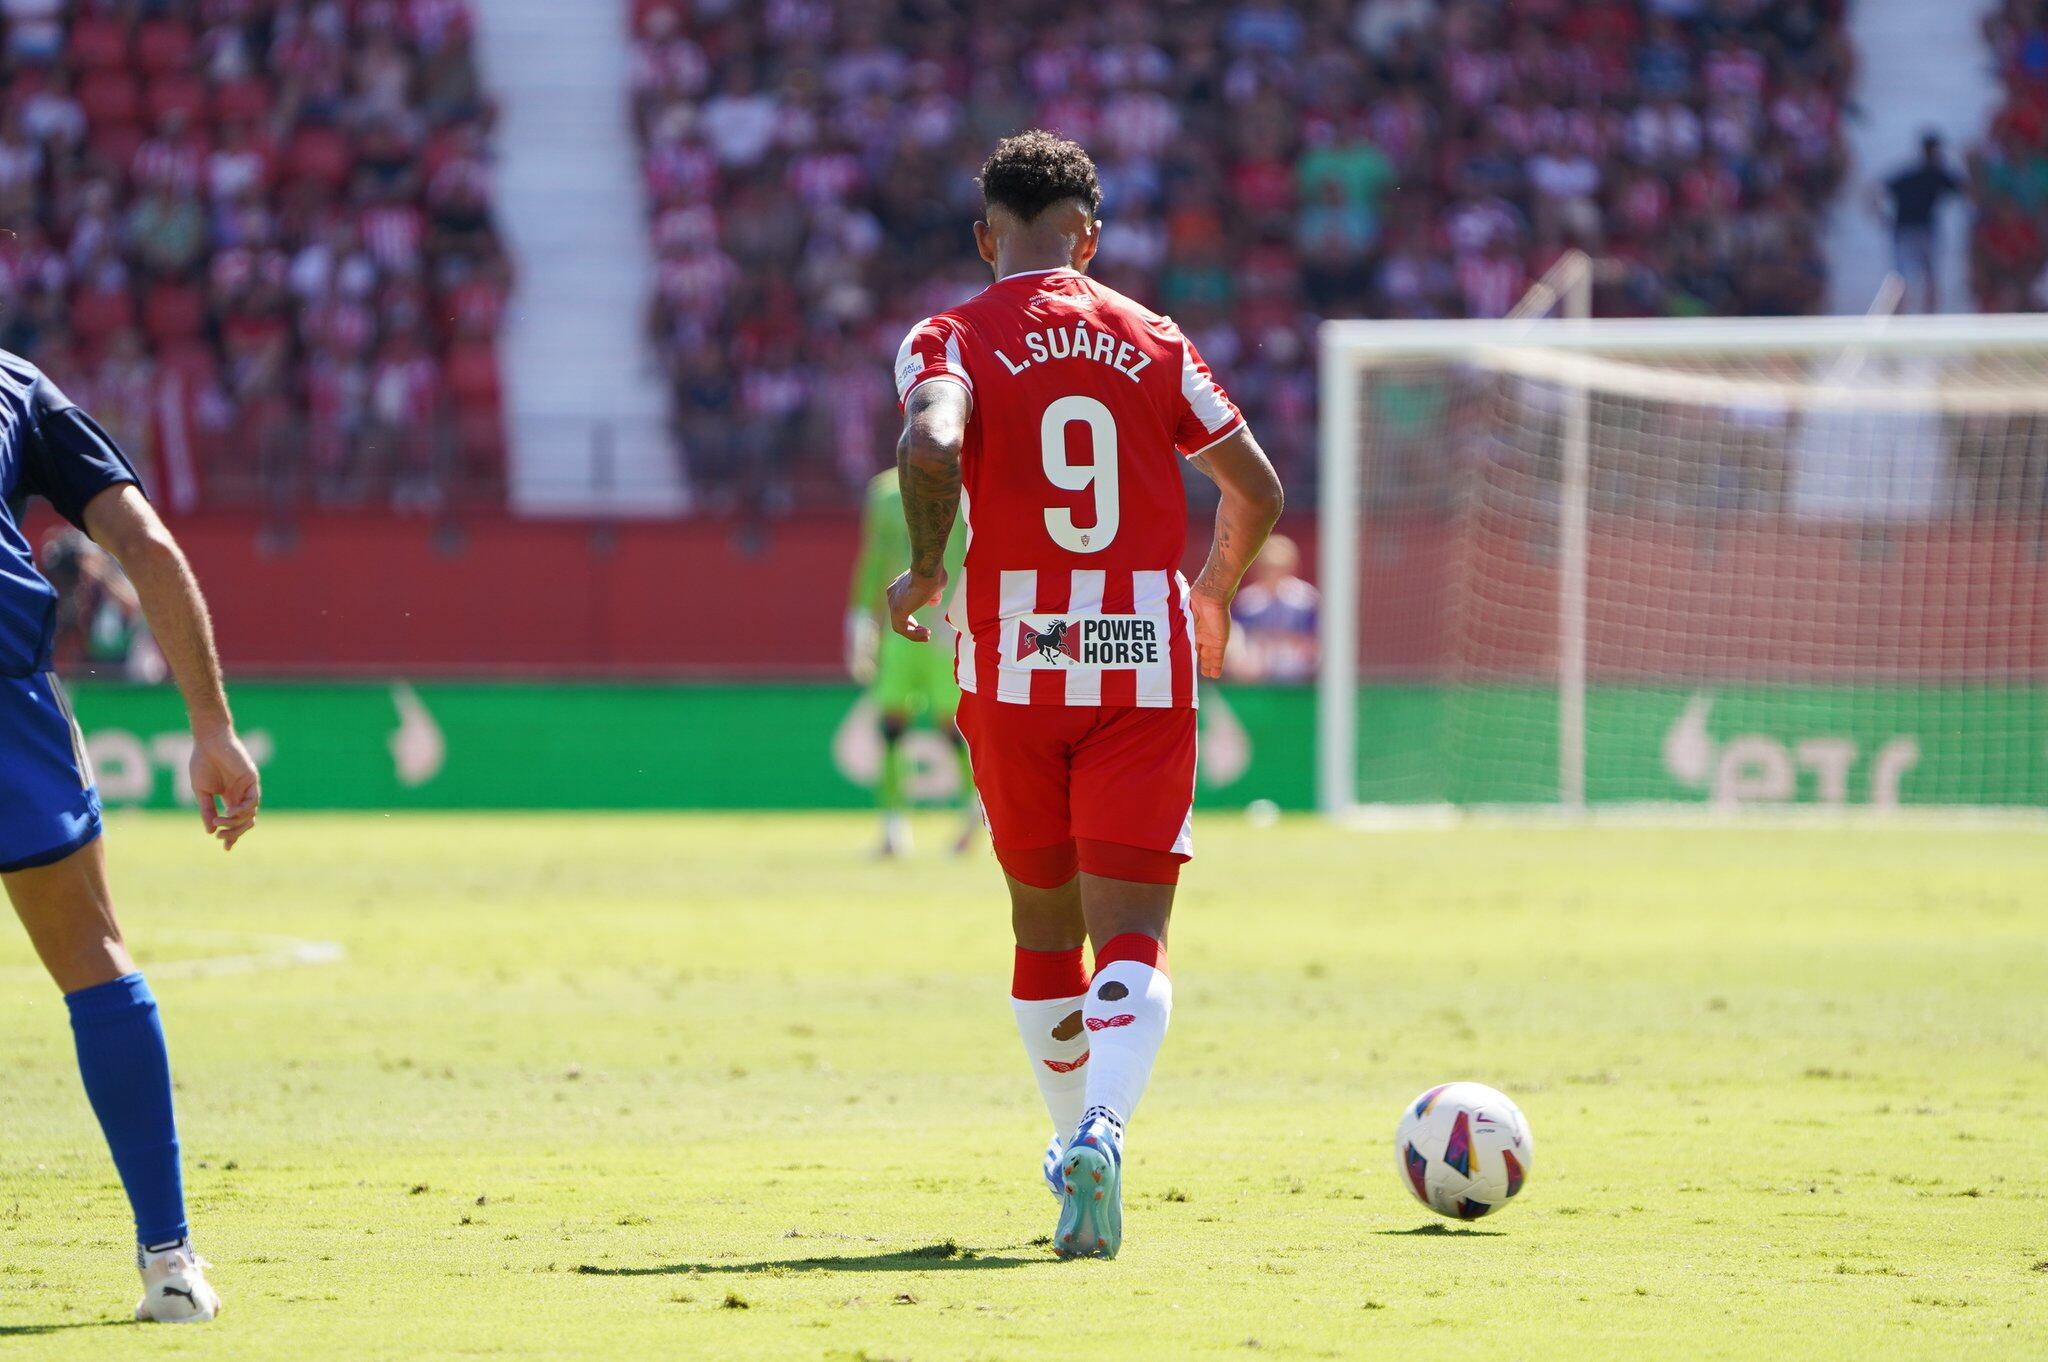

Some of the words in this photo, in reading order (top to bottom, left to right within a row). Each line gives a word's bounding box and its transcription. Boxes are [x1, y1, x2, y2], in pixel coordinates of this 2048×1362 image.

[994, 320, 1152, 384] L.SUÁREZ
[1041, 396, 1120, 554] 9
[1084, 619, 1157, 642] POWER
[1084, 641, 1159, 664] HORSE
